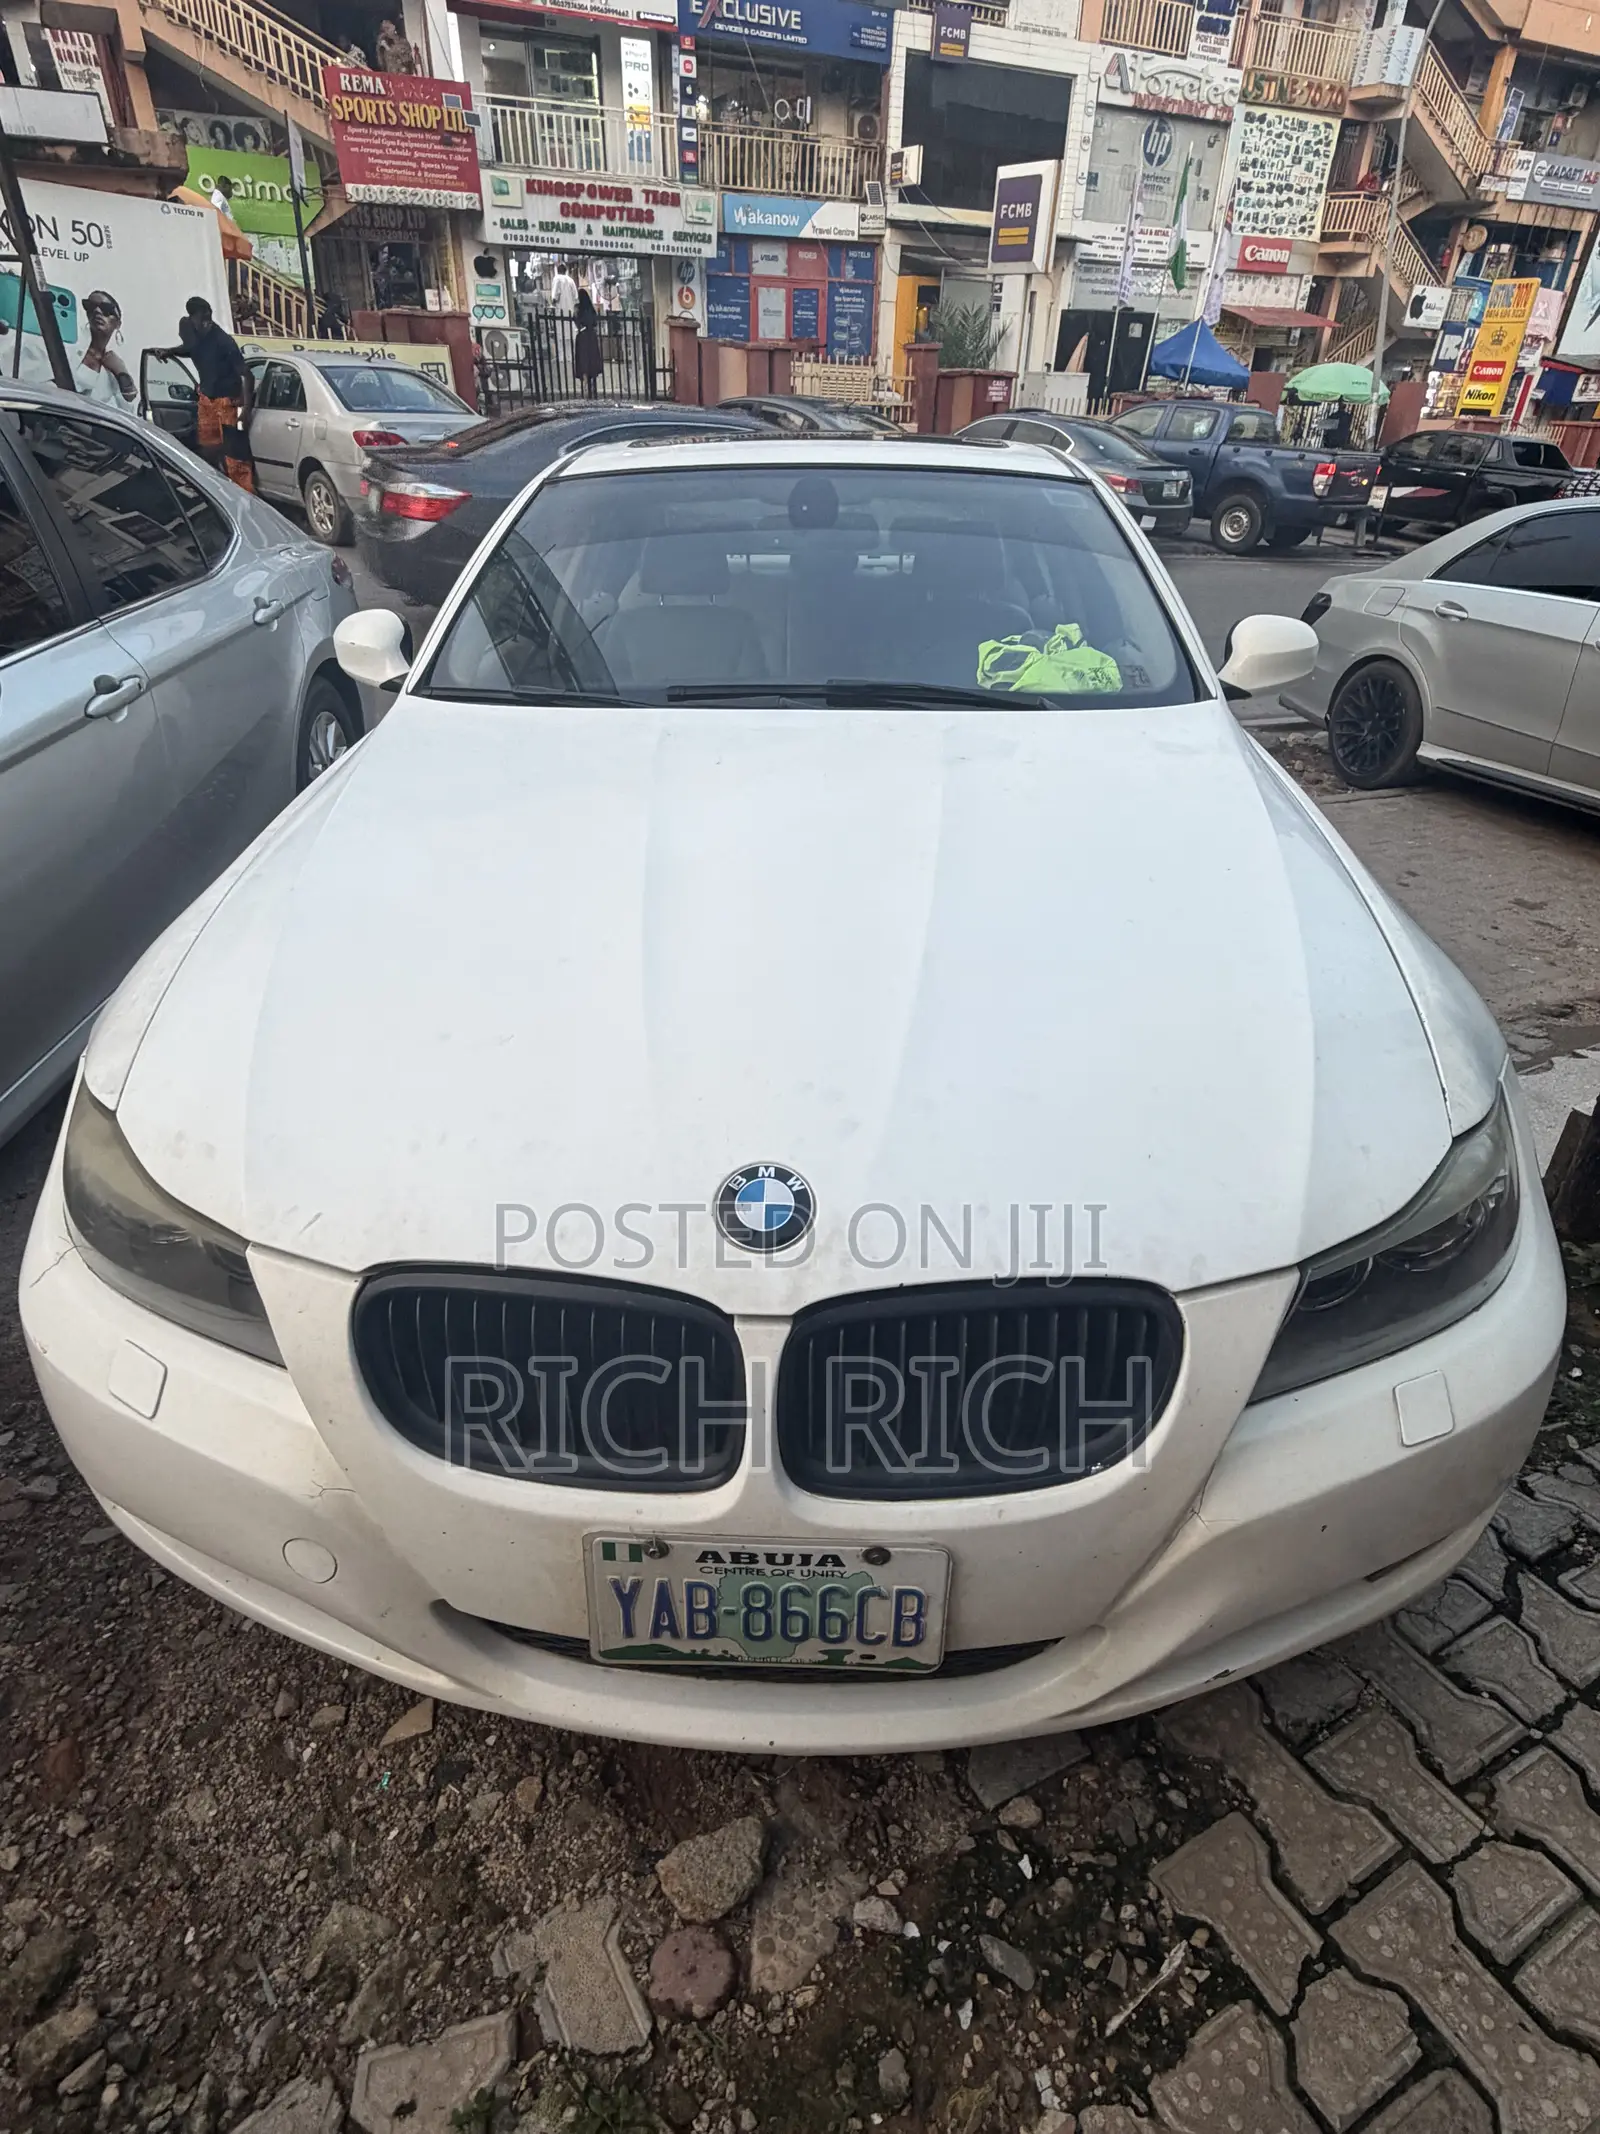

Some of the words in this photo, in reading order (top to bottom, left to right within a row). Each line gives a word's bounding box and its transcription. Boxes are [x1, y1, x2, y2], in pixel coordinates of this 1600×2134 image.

[714, 23, 745, 36] DEVICES
[782, 34, 808, 45] LIMITED
[940, 26, 970, 40] FCMB
[625, 60, 650, 72] PRO
[331, 94, 398, 126] SPORTS
[399, 101, 442, 131] SHOP
[1252, 170, 1291, 182] USTINE
[198, 173, 294, 203] oaimo
[560, 202, 656, 225] COMPUTERS
[733, 206, 801, 231] Wakanow
[1000, 202, 1032, 220] FCMB
[72, 219, 105, 248] 50
[499, 218, 529, 231] SALES
[538, 221, 576, 235] REPAIRS
[602, 225, 665, 242] MAINTENANCE
[672, 231, 713, 245] SERVICES
[811, 225, 833, 239] Travel
[833, 227, 856, 239] Centre
[38, 246, 70, 261] EVEL
[74, 251, 90, 263] UP
[1244, 244, 1291, 264] Canon
[292, 344, 397, 360] Rarkable
[1472, 364, 1504, 377] Canon
[1464, 388, 1497, 402] Nikon
[728, 1166, 805, 1192] BMW
[694, 1550, 846, 1568] ABUJA
[699, 1566, 768, 1577] CENTRE
[771, 1568, 796, 1578] OF
[799, 1569, 849, 1580] UNITY
